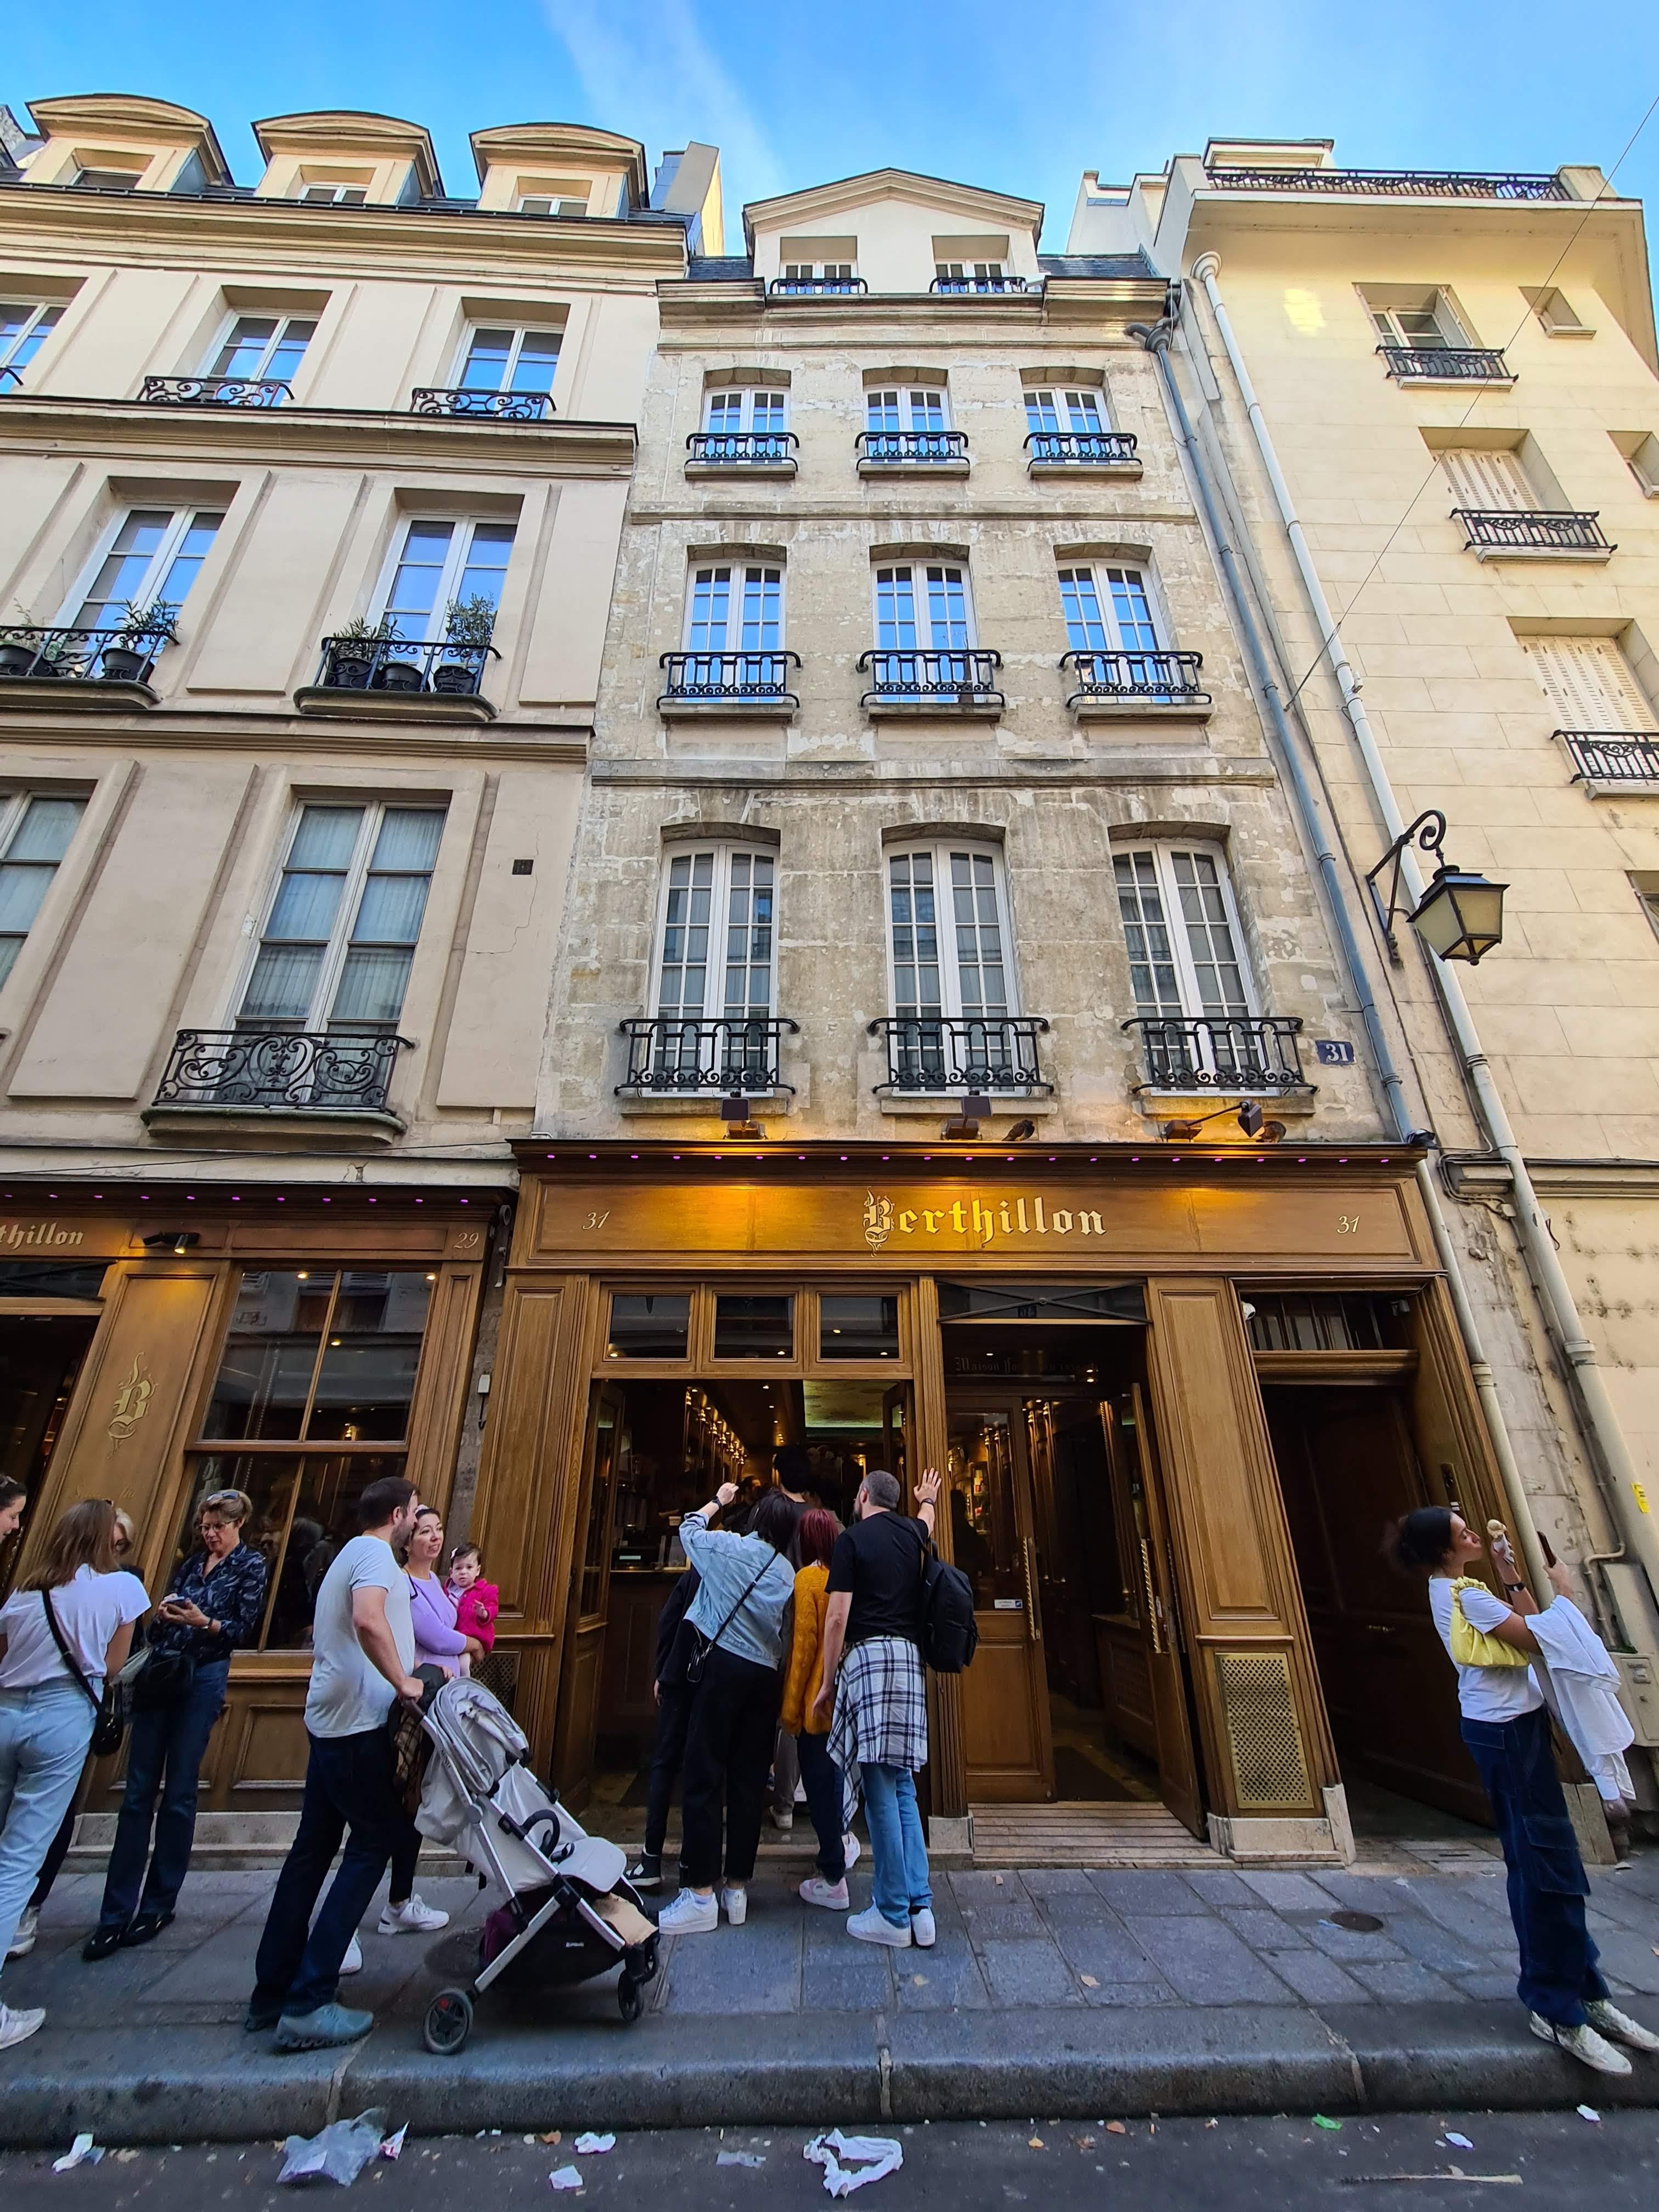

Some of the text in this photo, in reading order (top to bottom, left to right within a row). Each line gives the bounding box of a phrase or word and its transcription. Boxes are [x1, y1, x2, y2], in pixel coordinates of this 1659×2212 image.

[1325, 1043, 1349, 1062] 31
[582, 1210, 611, 1230] 31
[863, 1186, 1107, 1257] Berthillon
[1336, 1215, 1361, 1234] 31
[452, 1232, 479, 1249] 29
